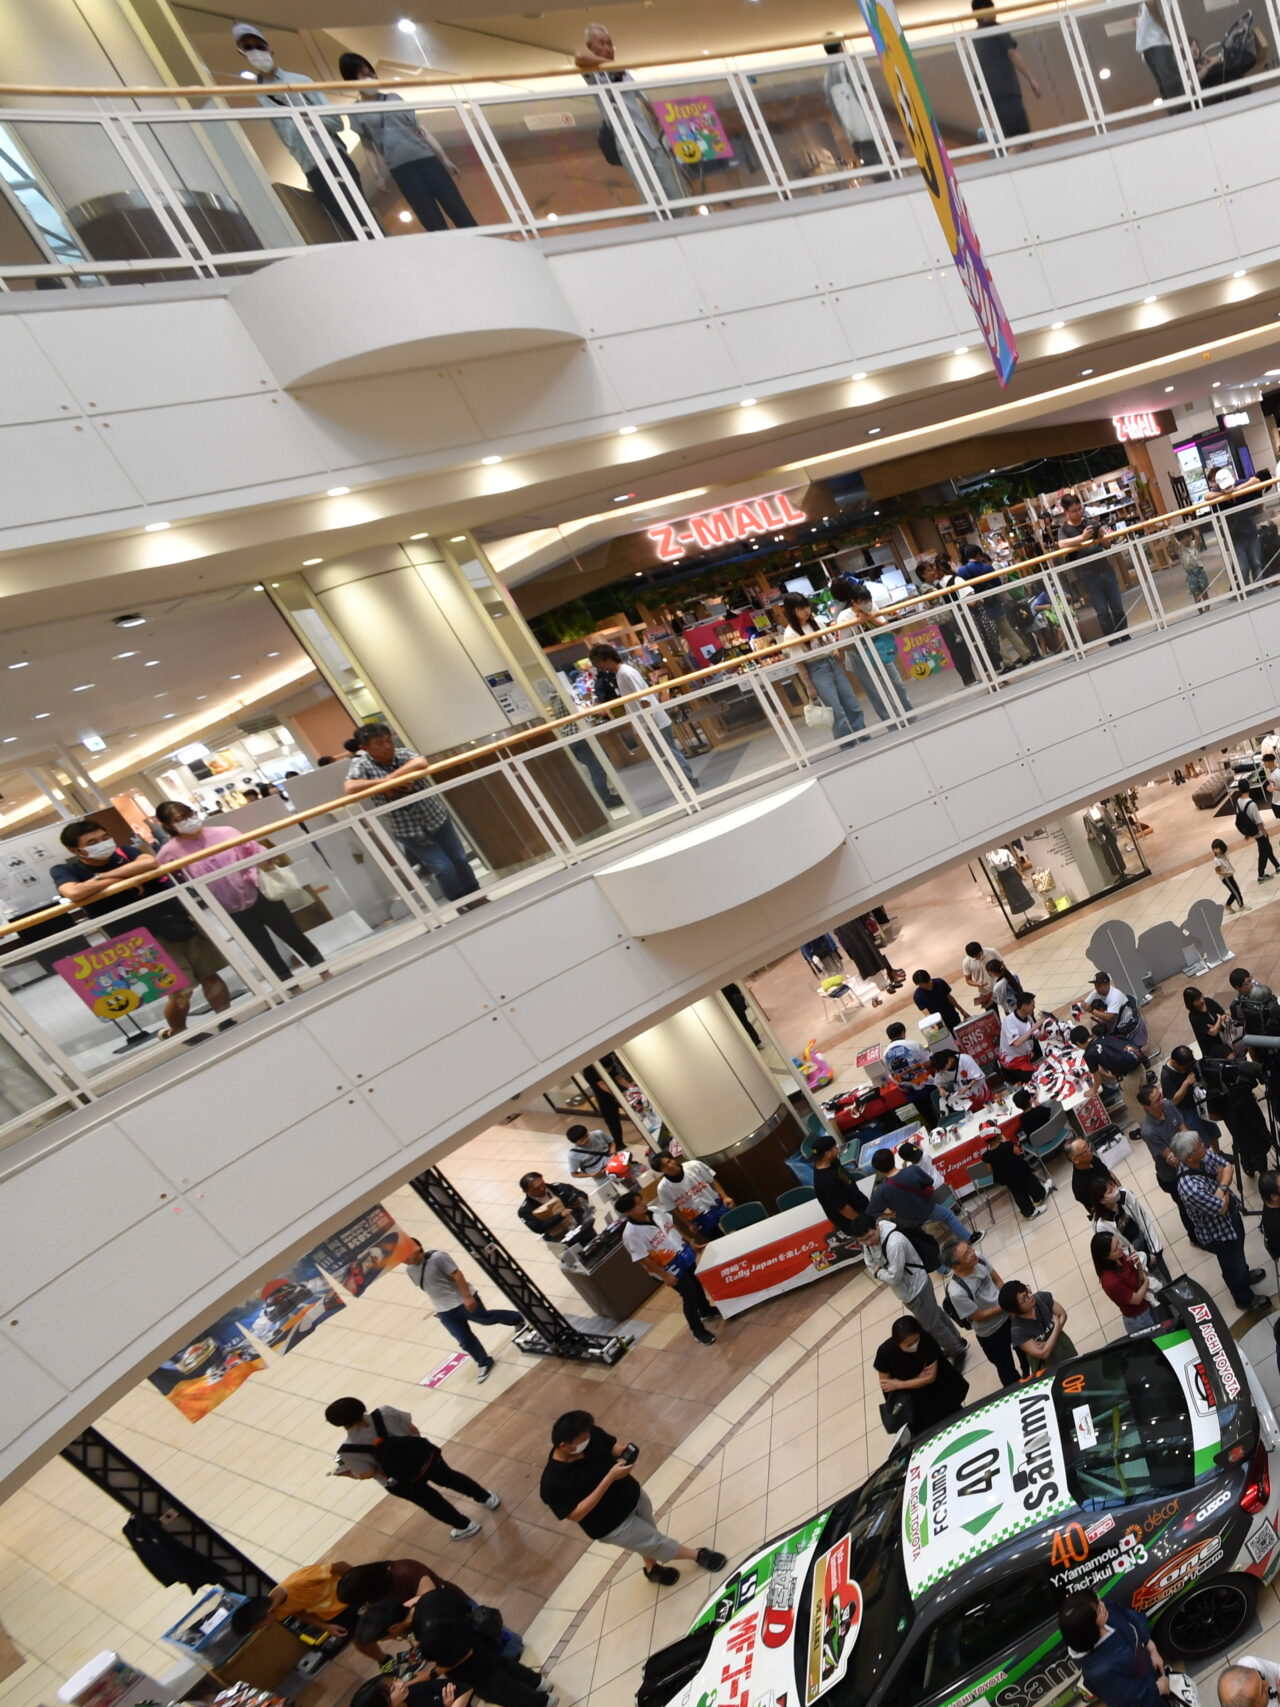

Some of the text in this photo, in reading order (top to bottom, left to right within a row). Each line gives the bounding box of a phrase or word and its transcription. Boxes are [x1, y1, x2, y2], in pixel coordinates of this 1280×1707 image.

[648, 493, 807, 562] Z-MALL
[962, 1028, 984, 1048] SNS
[725, 1267, 750, 1284] Rally
[1199, 1323, 1223, 1355] AICHI
[1213, 1350, 1241, 1401] TOYOTA
[956, 1448, 1000, 1497] 40
[1019, 1394, 1059, 1511] Sammy
[910, 1486, 922, 1562] AICHI TOYOTA
[1144, 1498, 1180, 1533] décor
[1050, 1522, 1090, 1568] 40
[1050, 1547, 1119, 1588] Y.Yamamoto
[813, 1598, 823, 1651] OKAZAKI
[973, 1671, 1008, 1696] TOYOTA
